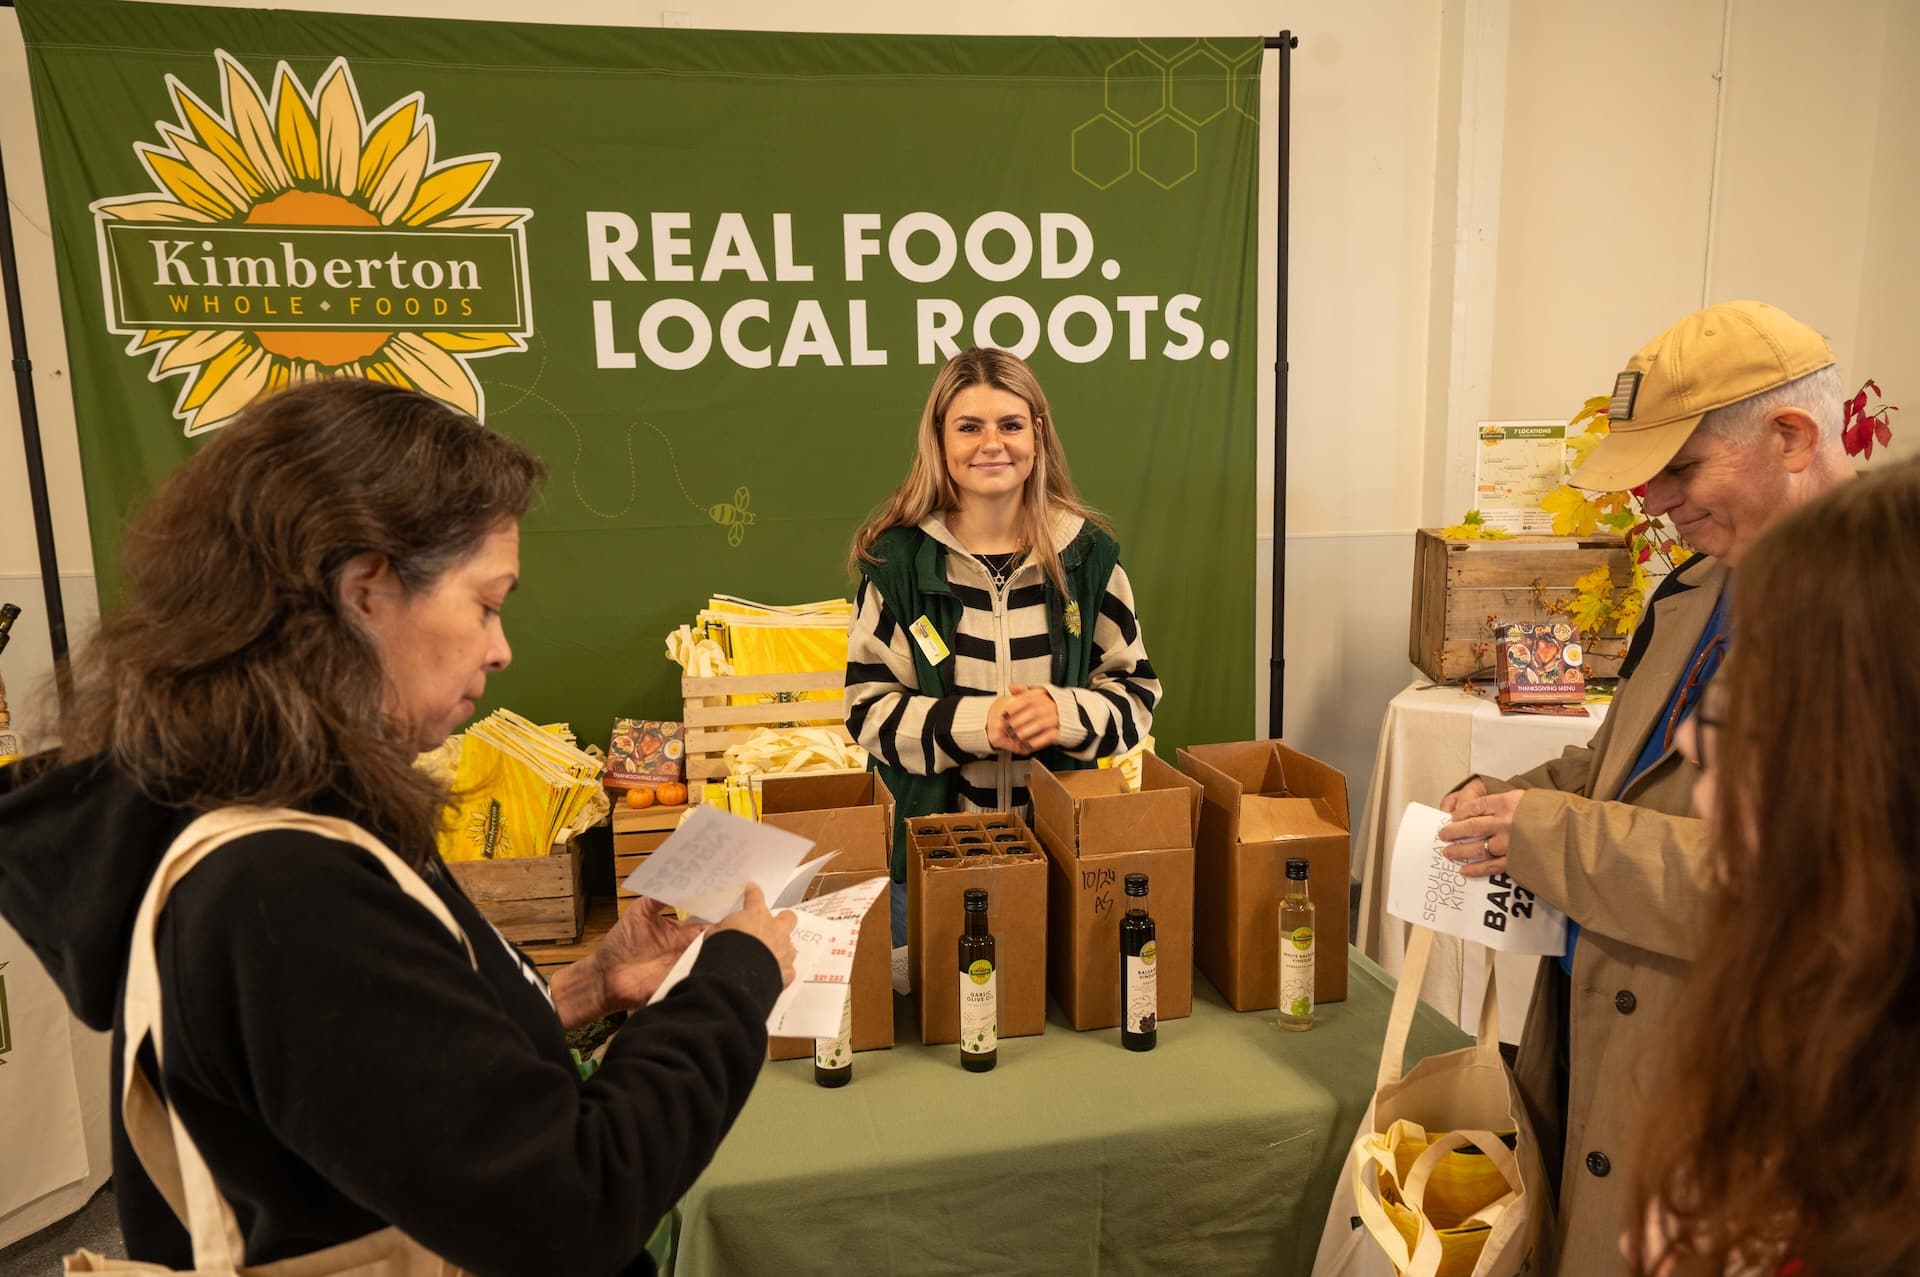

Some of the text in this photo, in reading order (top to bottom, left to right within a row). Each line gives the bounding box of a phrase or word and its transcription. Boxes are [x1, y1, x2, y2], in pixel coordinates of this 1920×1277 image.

[148, 240, 482, 289] Kimberton
[586, 211, 1120, 283] REAL FOOD.
[169, 295, 473, 316] WHOLE FOODS
[592, 293, 1230, 371] LOCAL ROOTS.
[485, 806, 497, 854] Kimberton
[1082, 868, 1116, 890] 10/24
[1423, 817, 1453, 922] SEOULMATS
[1484, 872, 1513, 932] BAR
[1511, 886, 1535, 919] 22
[792, 928, 823, 944] KER
